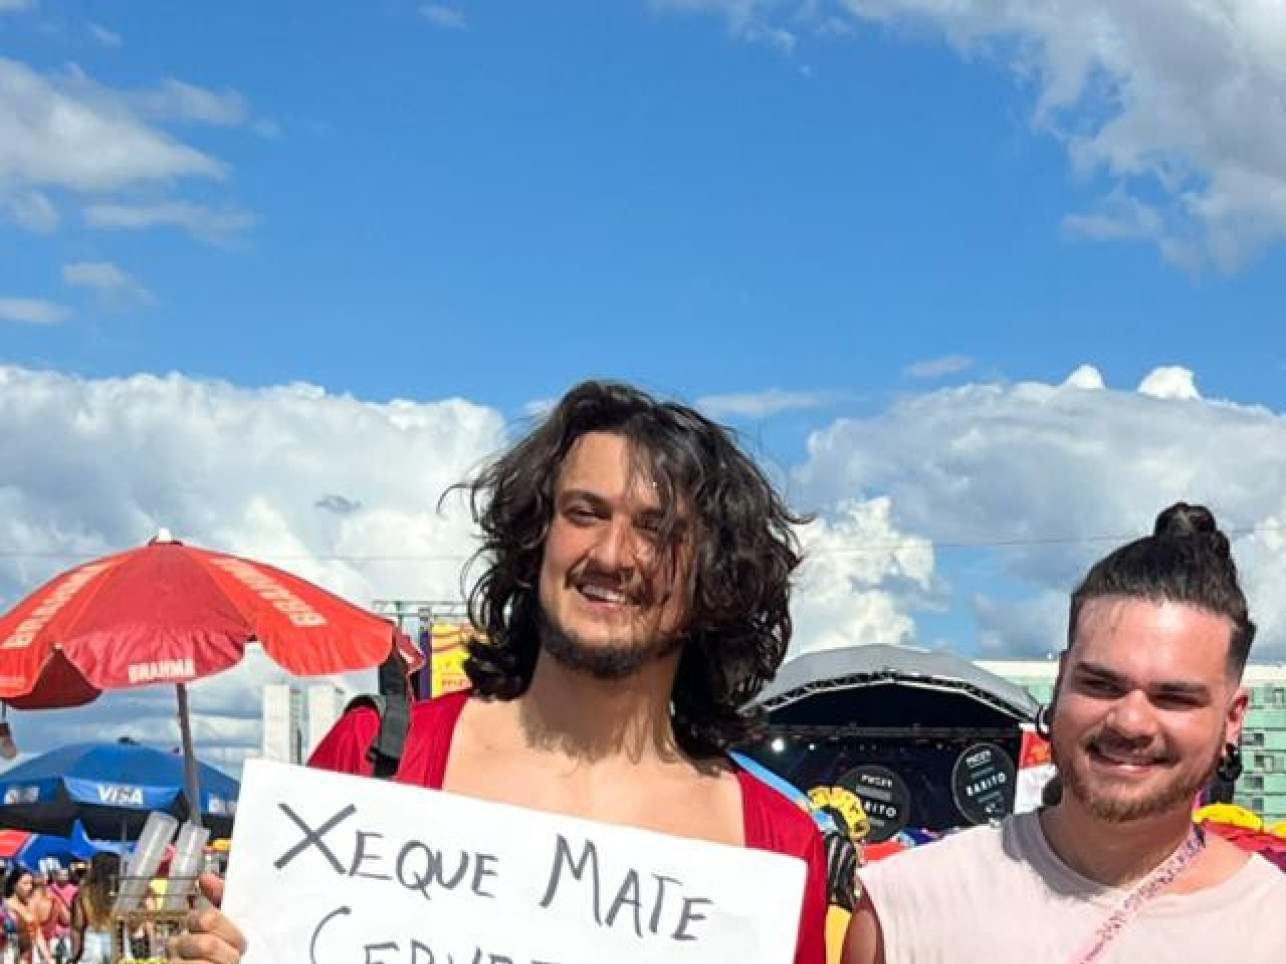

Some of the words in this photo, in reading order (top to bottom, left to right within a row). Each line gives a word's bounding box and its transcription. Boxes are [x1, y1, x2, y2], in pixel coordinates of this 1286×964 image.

[97, 784, 144, 808] VISA
[273, 802, 499, 897] XEQUE
[539, 834, 714, 943] MATE
